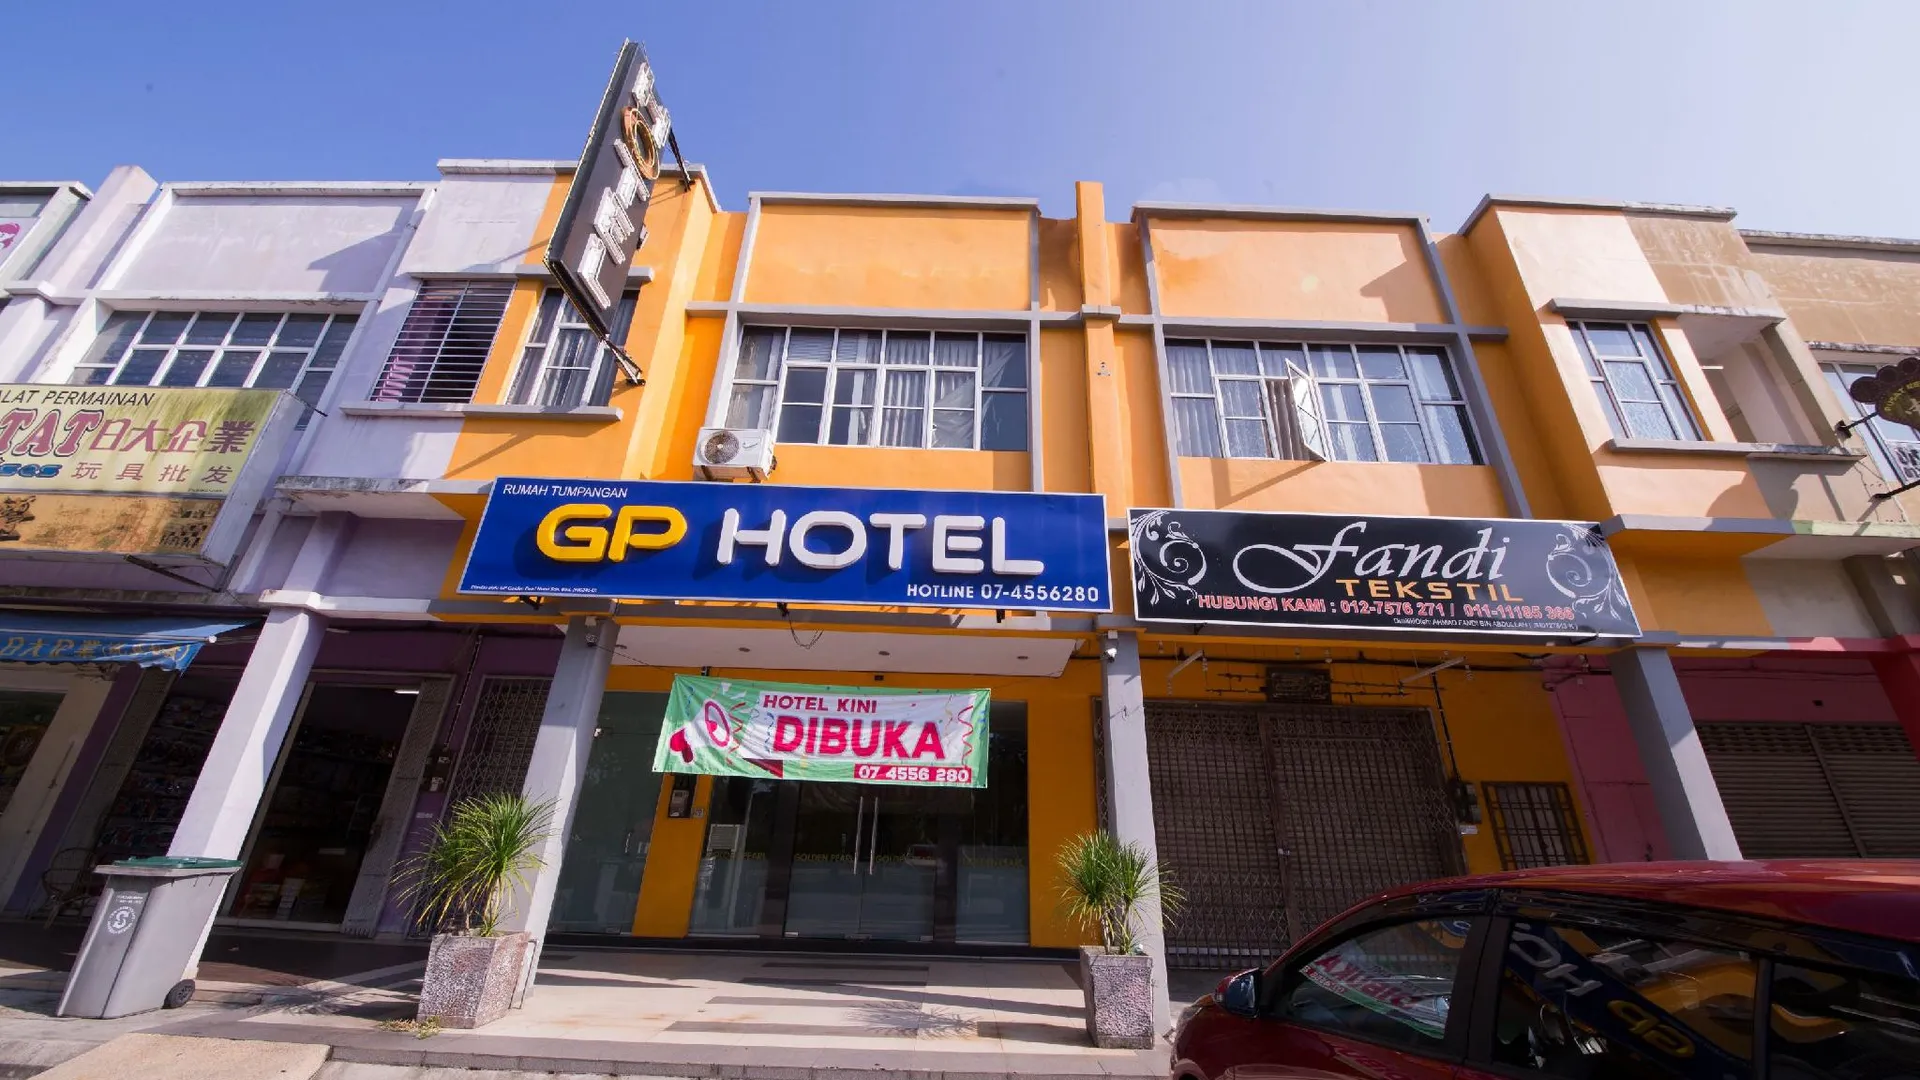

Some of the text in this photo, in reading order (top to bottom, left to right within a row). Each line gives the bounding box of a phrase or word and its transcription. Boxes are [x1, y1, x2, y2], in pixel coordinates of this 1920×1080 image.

[0, 390, 155, 406] LAT PERMAINAN
[89, 417, 255, 454] 日大企業
[70, 462, 232, 484] 玩具批发
[503, 484, 628, 498] RUMAH TUMPANGAN
[536, 503, 1045, 575] GP HOTEL
[907, 584, 1099, 602] HOTLINE 07-4556280
[1336, 579, 1523, 602] TEKSTIL
[1198, 595, 1279, 611] HUBUNGI
[1281, 598, 1327, 613] KAMI
[1340, 600, 1414, 616] 012-7576
[1416, 602, 1446, 617] 271
[763, 694, 877, 714] HOTEL KINI
[772, 715, 945, 761] DIBUKA
[858, 764, 969, 782] 07 4556 280
